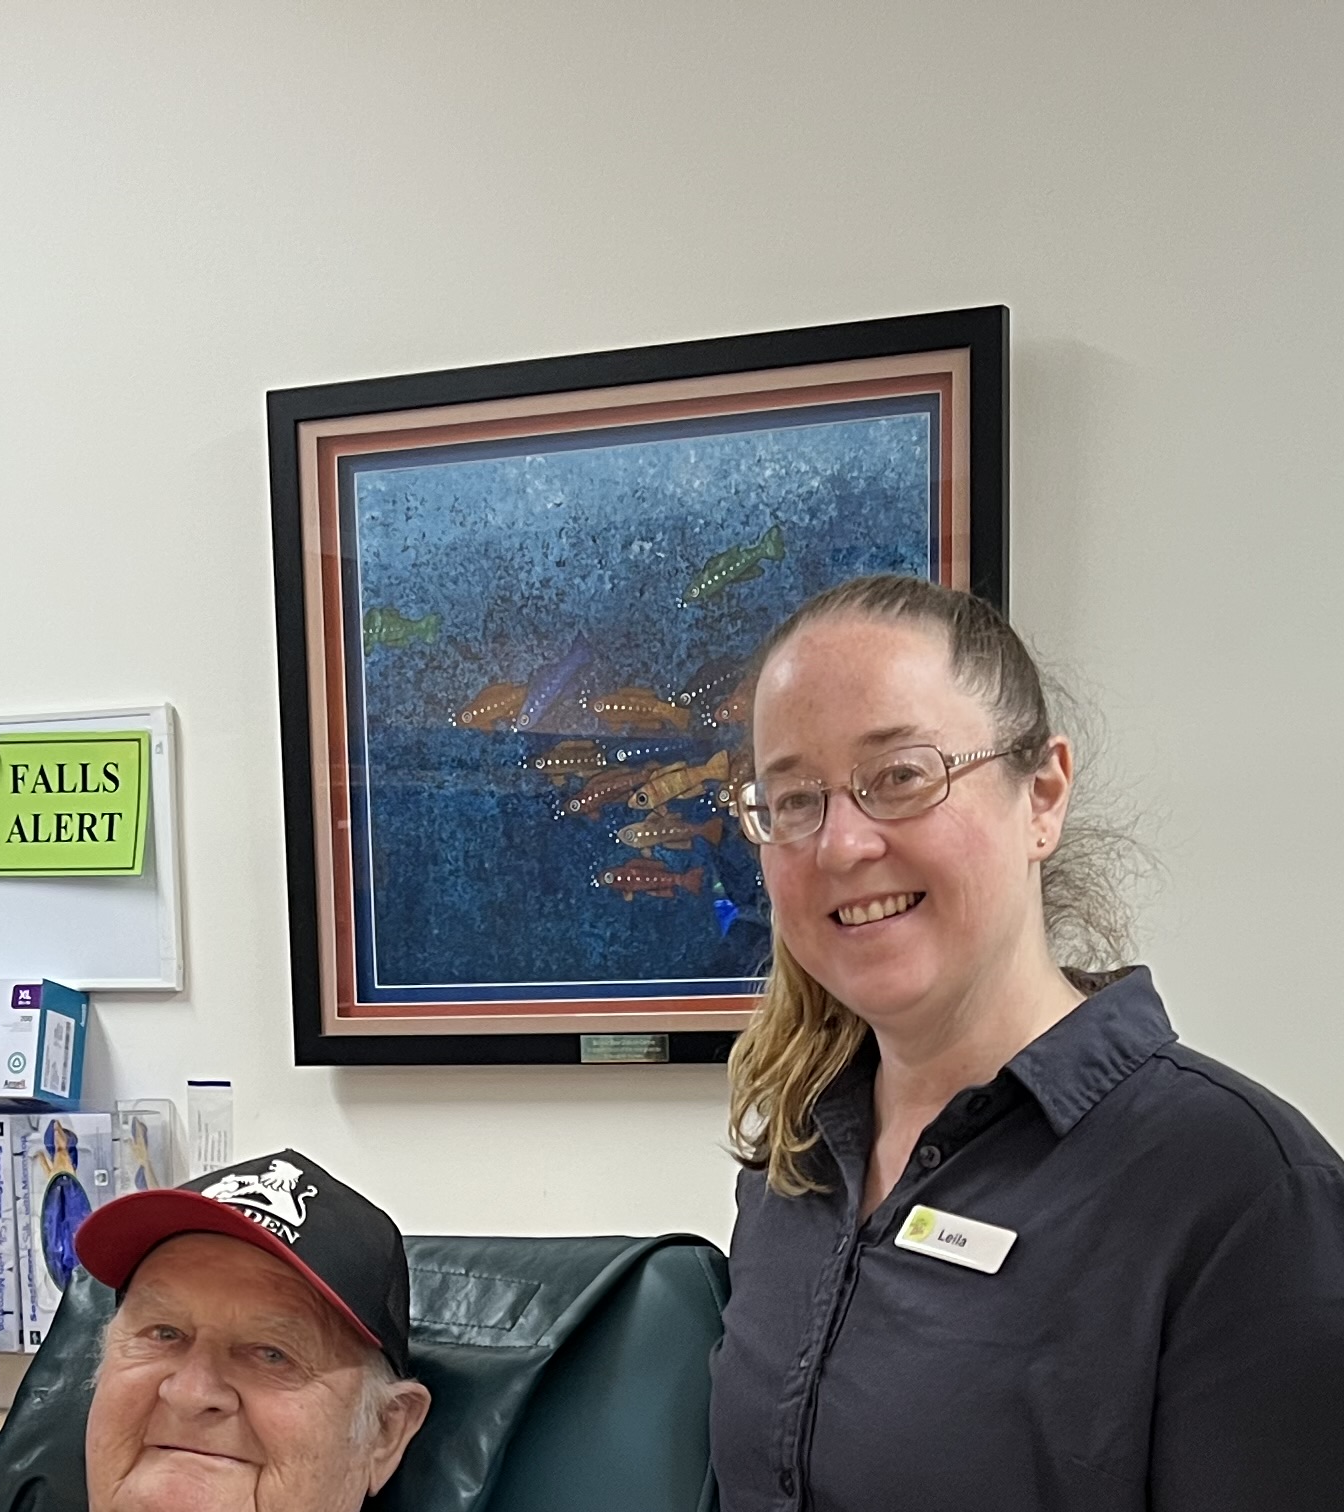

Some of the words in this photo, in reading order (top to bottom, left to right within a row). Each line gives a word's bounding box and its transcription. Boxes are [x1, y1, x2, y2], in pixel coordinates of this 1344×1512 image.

[9, 762, 120, 794] FALLS
[5, 812, 123, 843] ALERT
[18, 989, 32, 1000] XL
[243, 1208, 301, 1244] DEN
